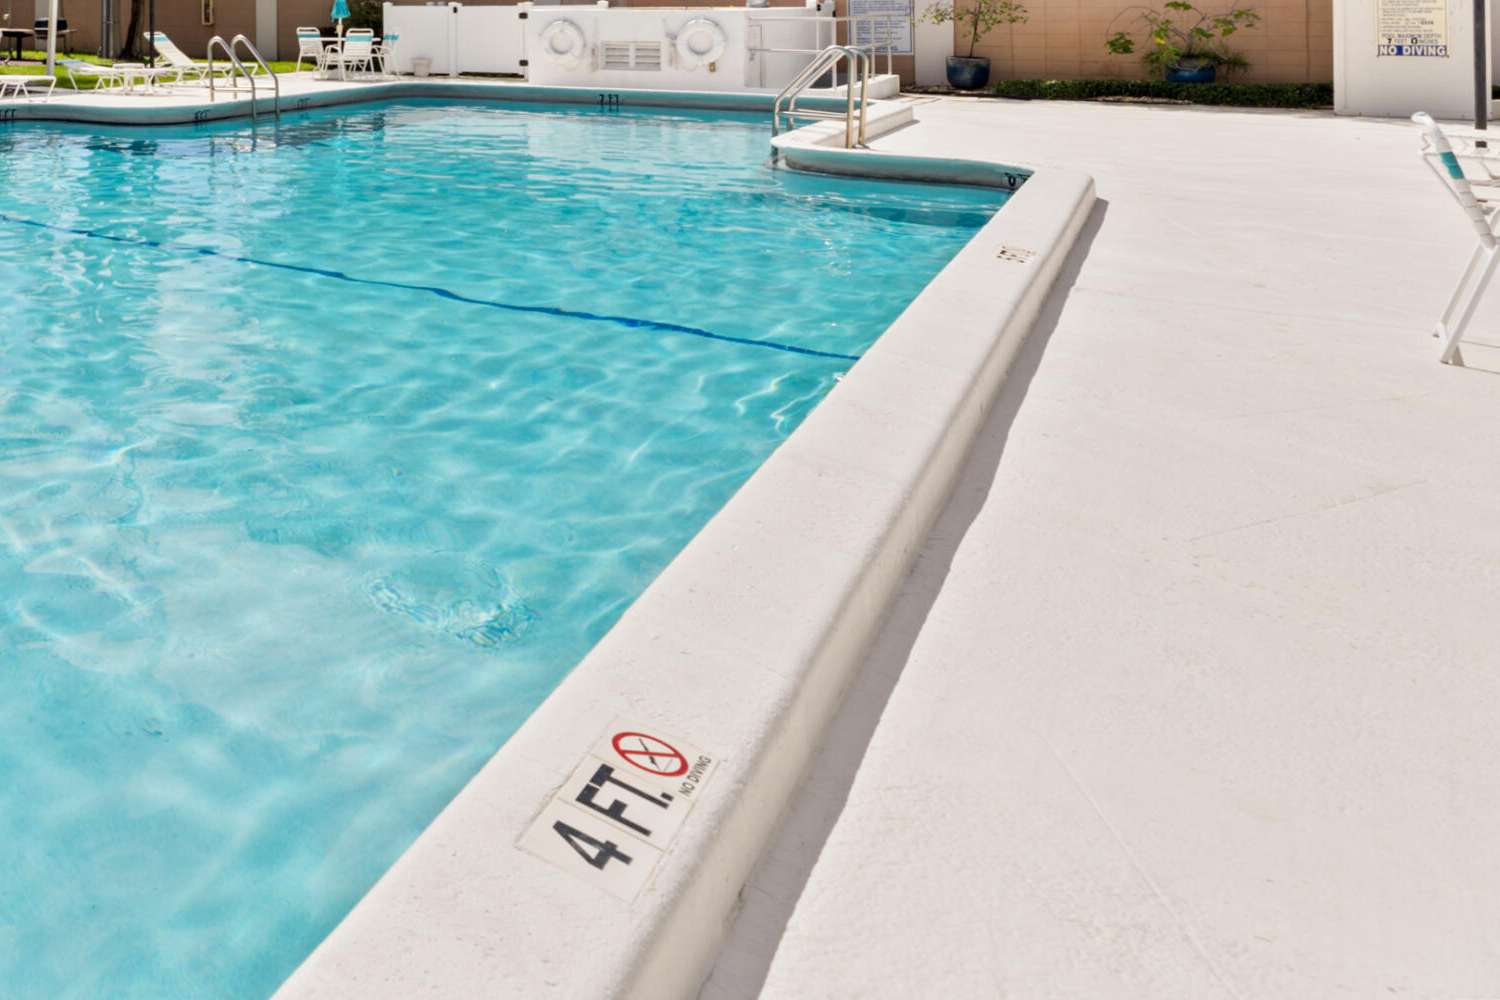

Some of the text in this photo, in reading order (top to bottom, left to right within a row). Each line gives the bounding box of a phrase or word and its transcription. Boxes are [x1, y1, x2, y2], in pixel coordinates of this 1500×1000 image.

[1379, 45, 1446, 56] NO DIVING
[678, 755, 712, 797] NO DIVING
[552, 763, 675, 871] 4 FT.
